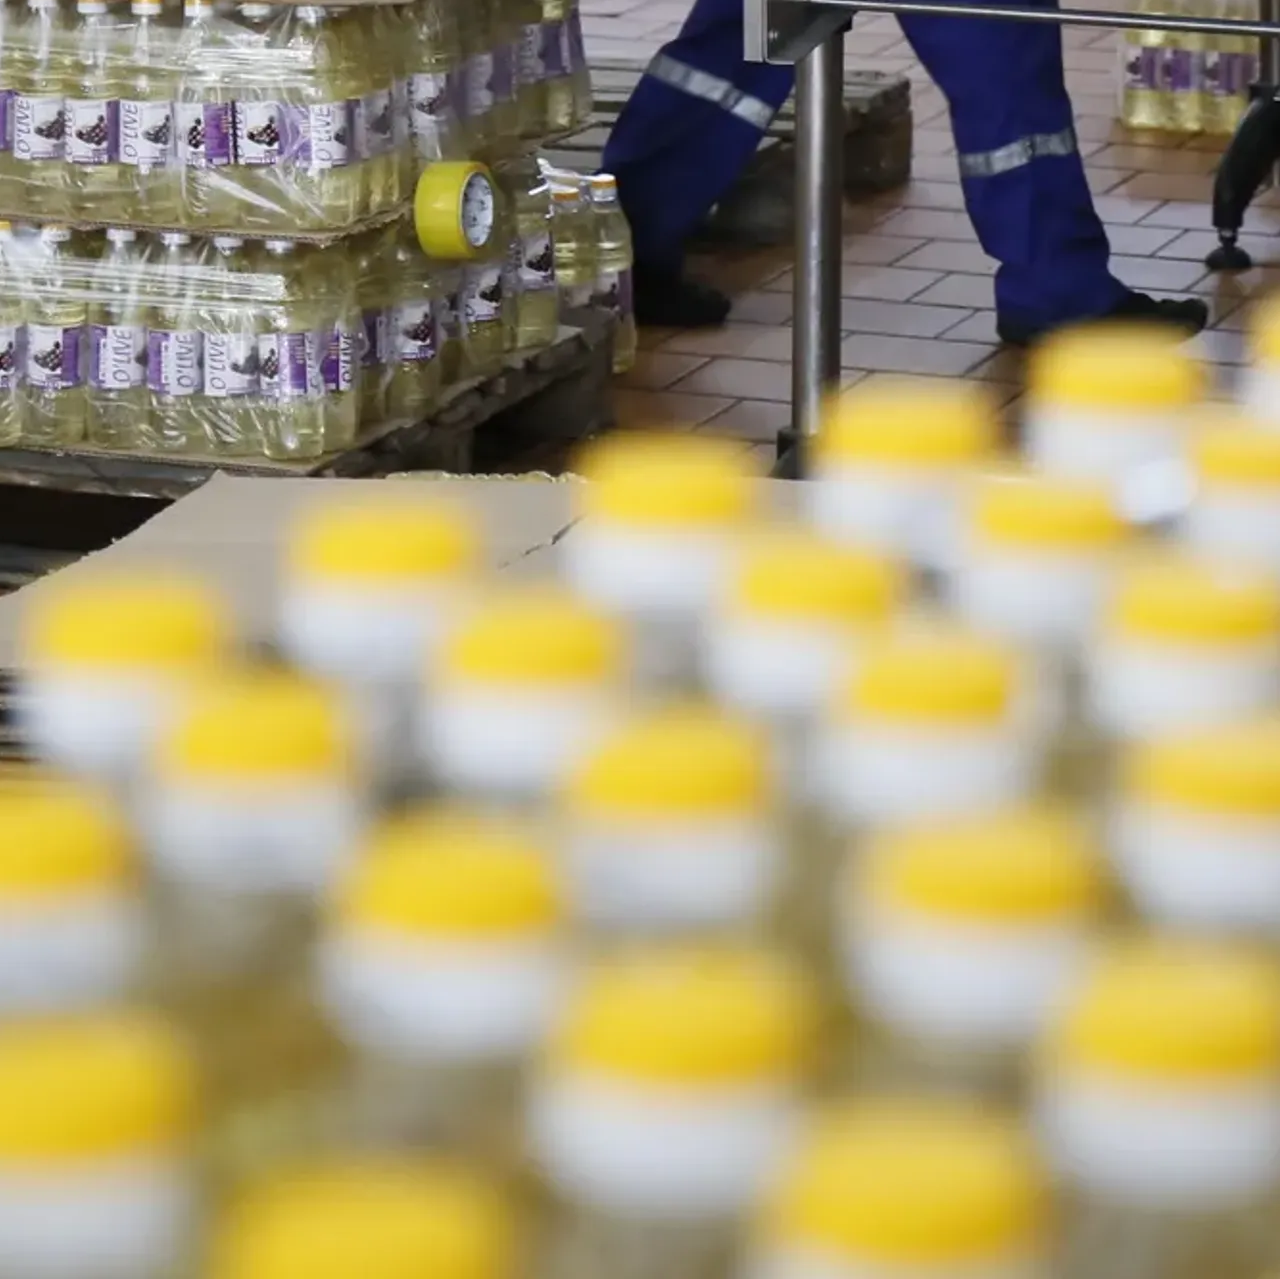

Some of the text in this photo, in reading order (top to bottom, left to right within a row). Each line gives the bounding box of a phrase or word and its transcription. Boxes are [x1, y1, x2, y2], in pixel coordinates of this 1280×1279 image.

[15, 99, 31, 154] O'LIVE
[121, 103, 138, 158] O'LIVE
[112, 327, 132, 384] O'LIVE
[176, 332, 194, 388] O'LIVE
[209, 332, 227, 390] O'LIVE
